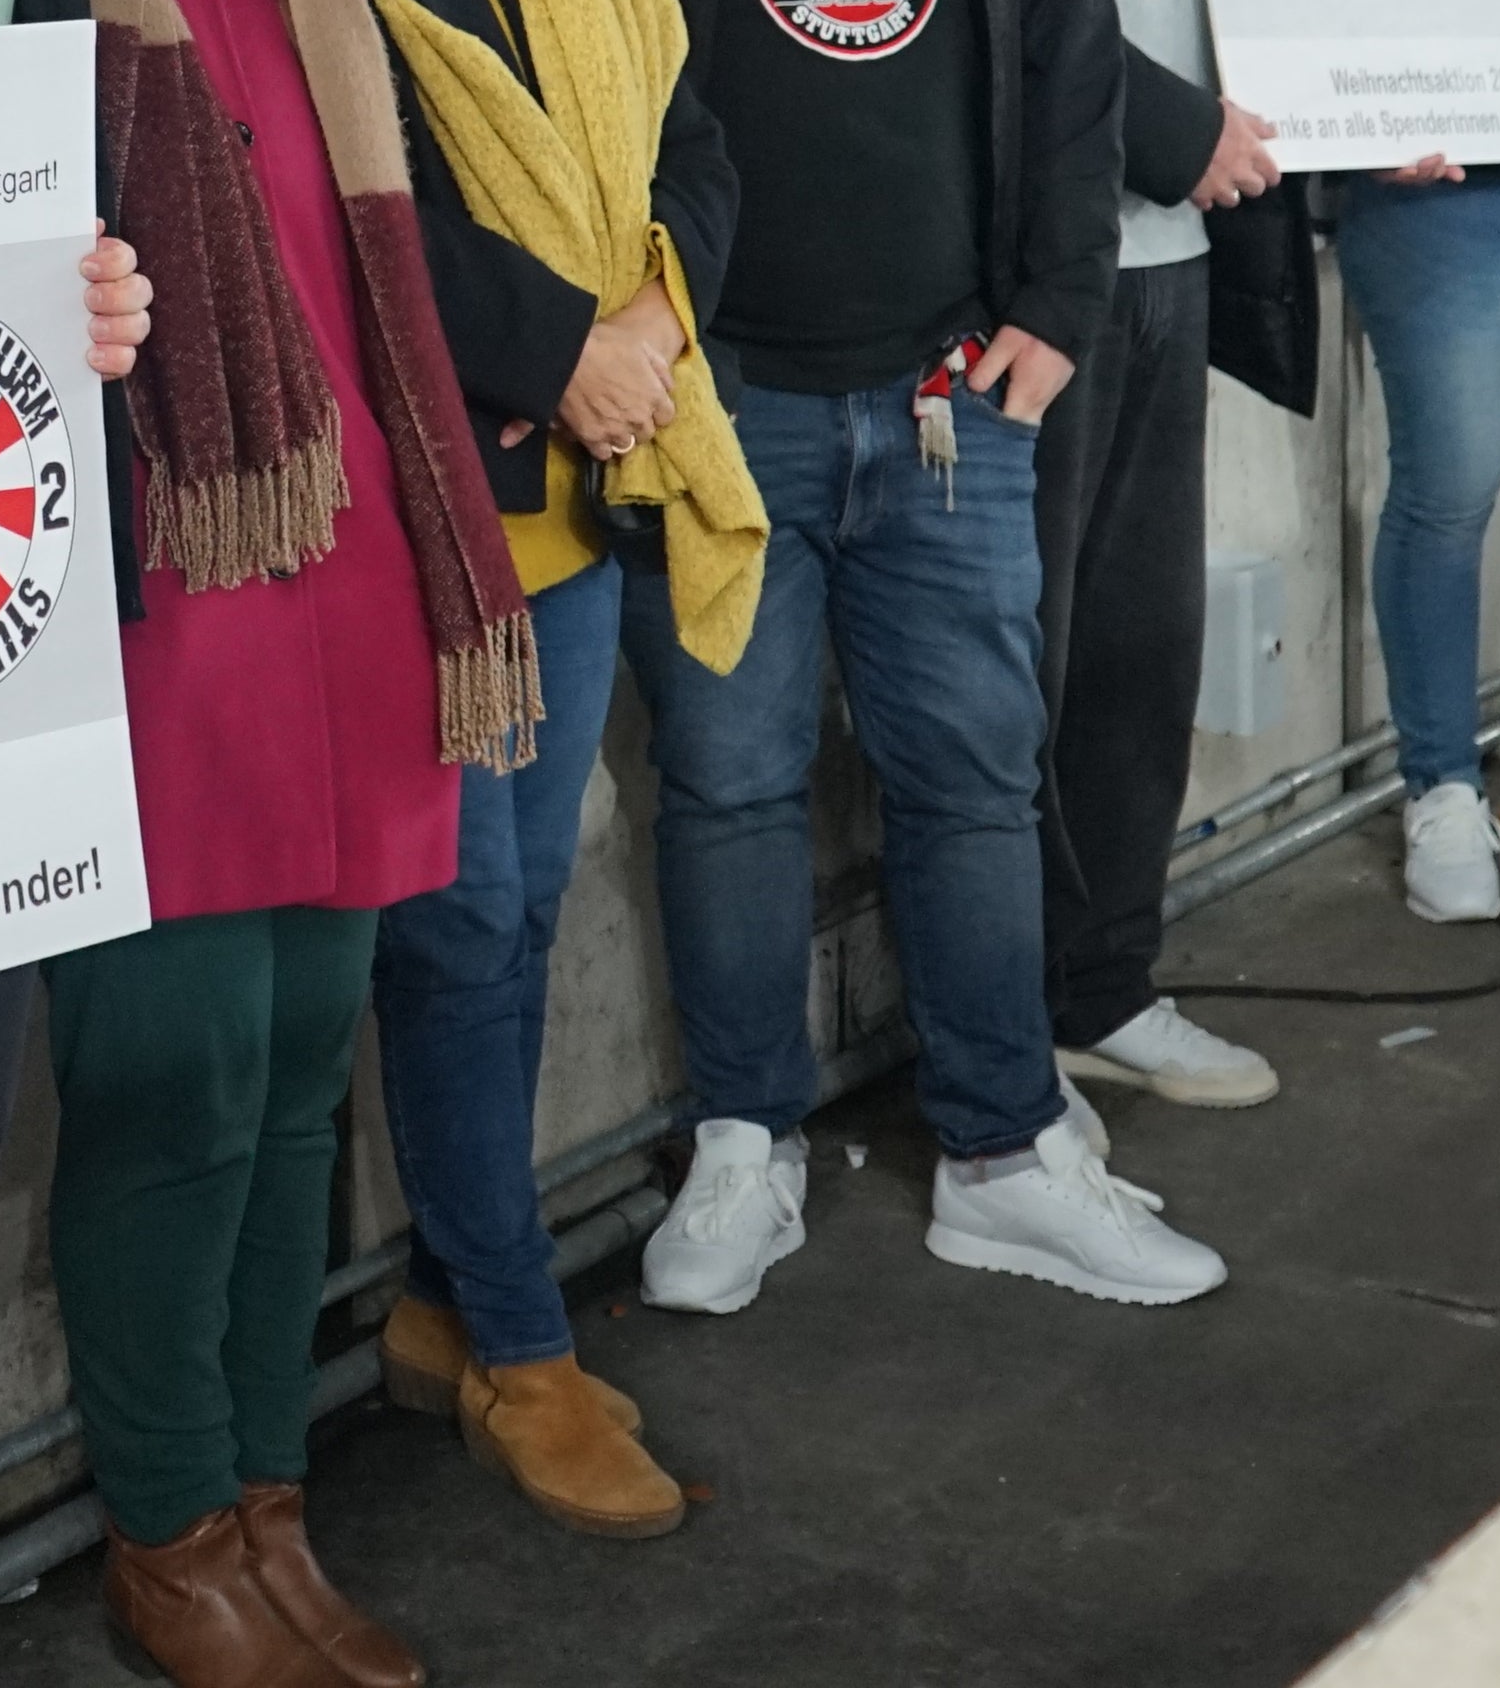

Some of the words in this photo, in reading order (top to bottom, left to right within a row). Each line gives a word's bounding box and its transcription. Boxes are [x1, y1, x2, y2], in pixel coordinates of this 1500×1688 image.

[790, 0, 915, 47] STUTTGART
[1329, 67, 1488, 96] Weihnachtsaktion
[1318, 116, 1341, 139] an
[1345, 110, 1376, 139] alle
[1381, 108, 1500, 144] Spenderinnen
[40, 462, 69, 531] 2
